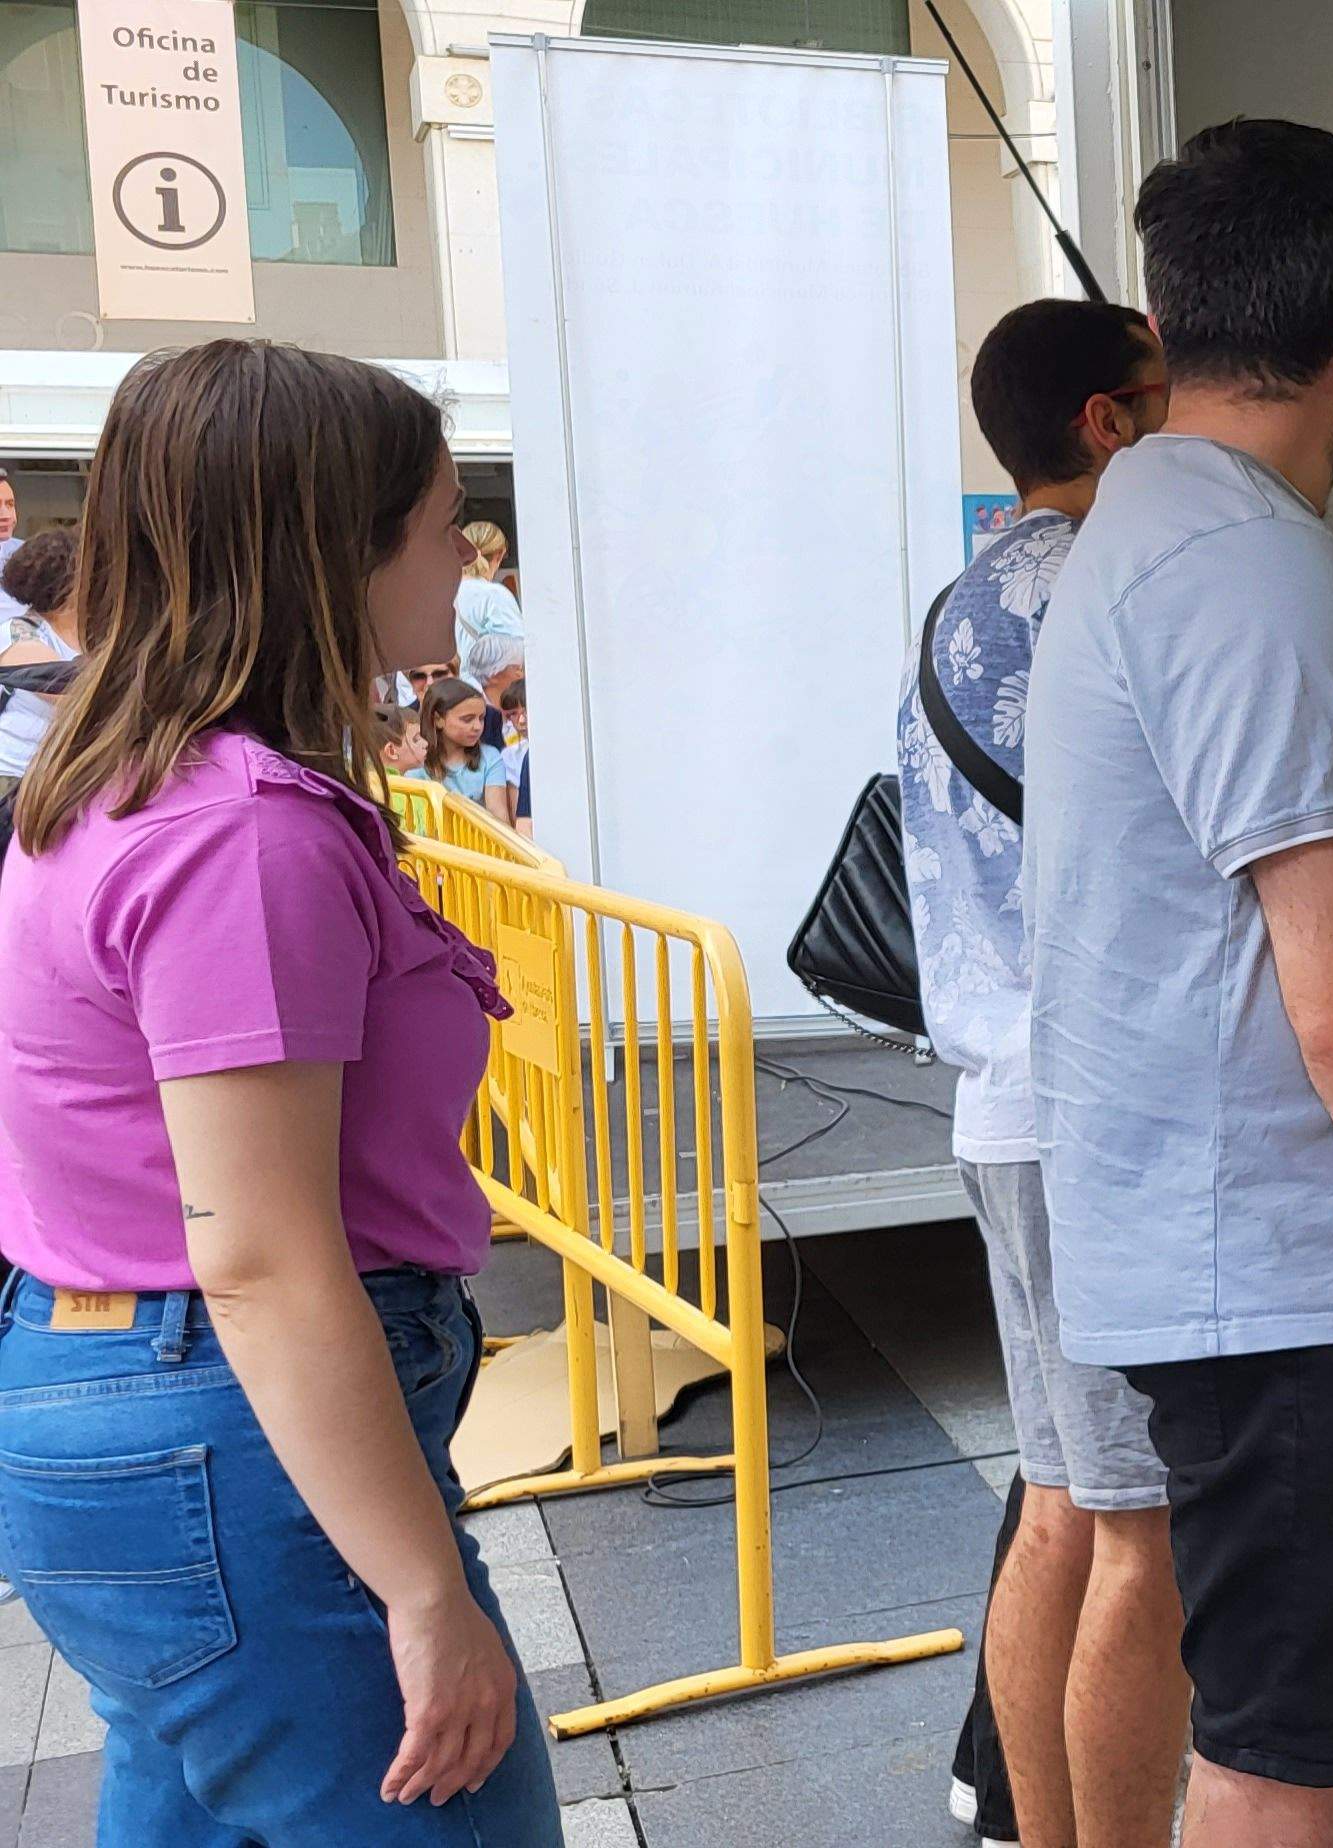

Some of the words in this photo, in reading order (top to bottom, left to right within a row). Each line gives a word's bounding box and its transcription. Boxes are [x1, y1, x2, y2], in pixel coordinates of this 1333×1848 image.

[112, 26, 216, 54] Oficina
[183, 61, 218, 82] de
[102, 84, 220, 112] Turismo
